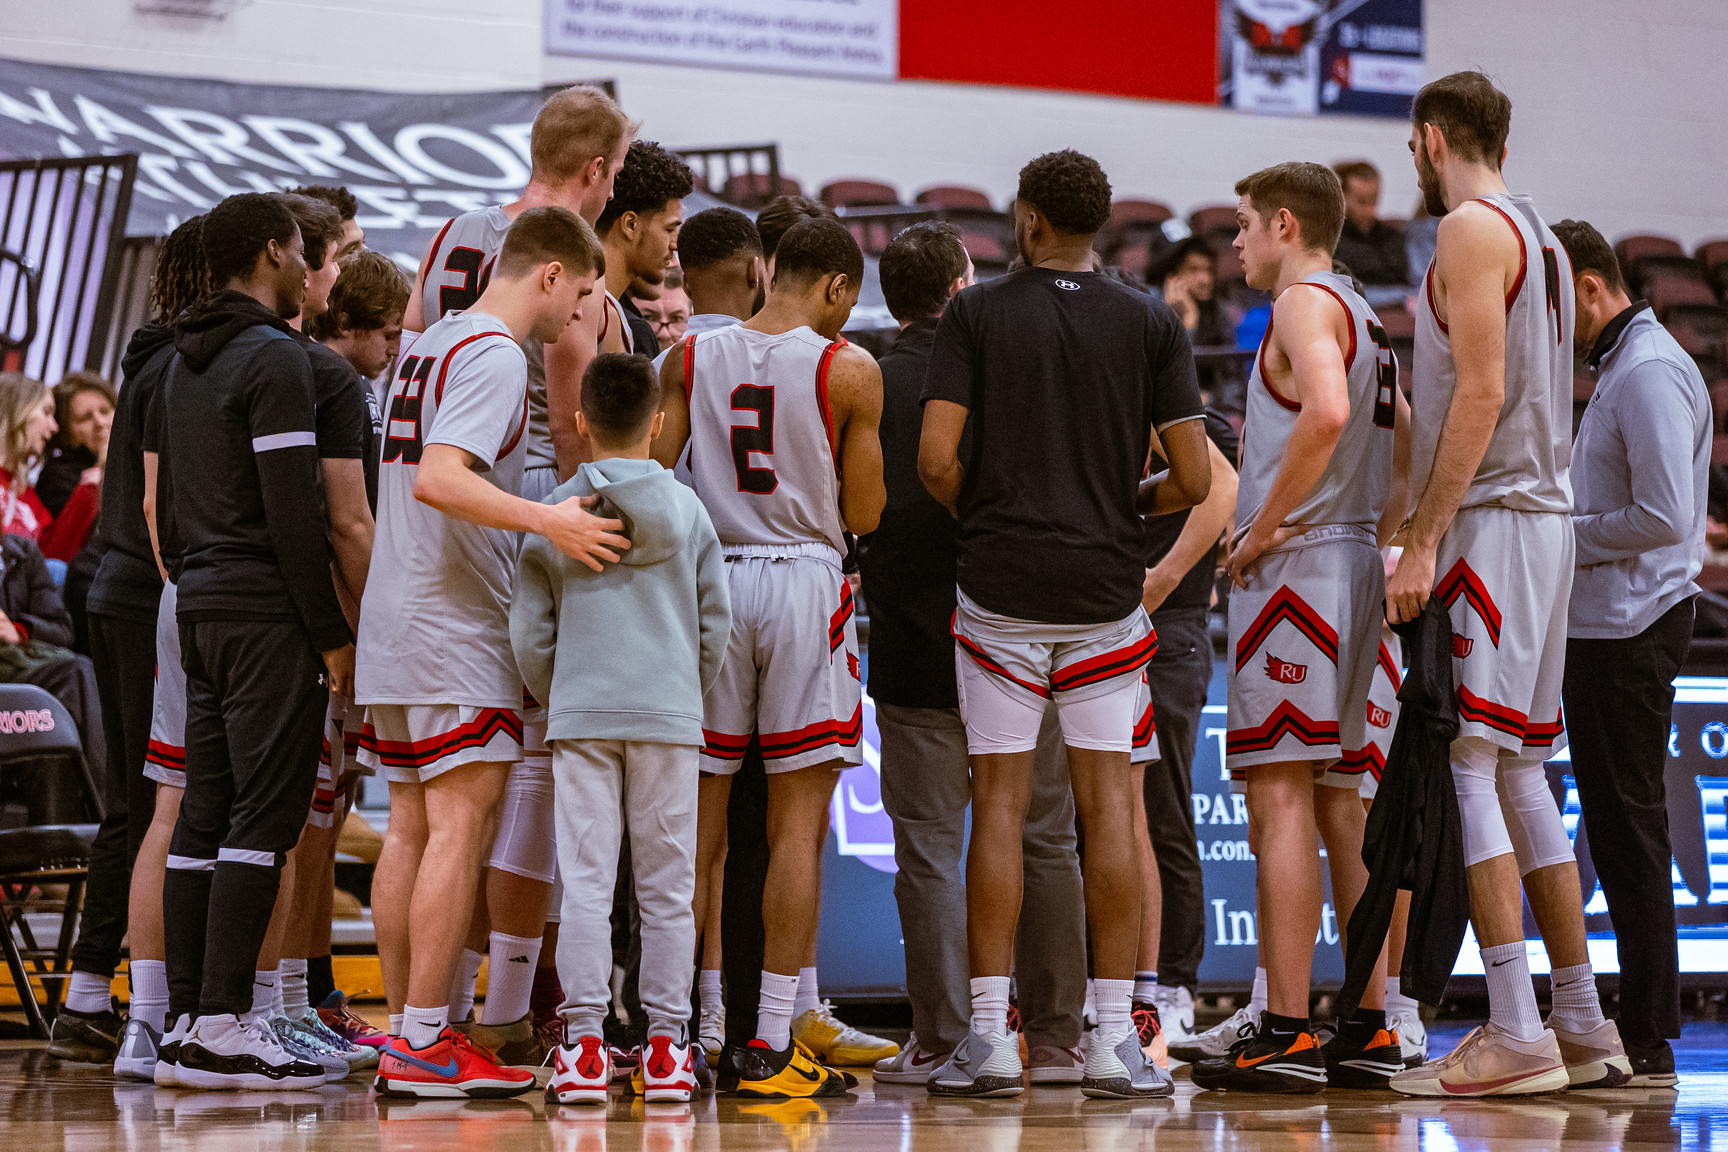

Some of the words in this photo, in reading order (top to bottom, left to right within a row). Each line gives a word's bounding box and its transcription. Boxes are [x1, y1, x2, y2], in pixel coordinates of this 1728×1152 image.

[730, 383, 779, 495] 2
[1280, 664, 1306, 682] RU
[1371, 707, 1391, 727] RU
